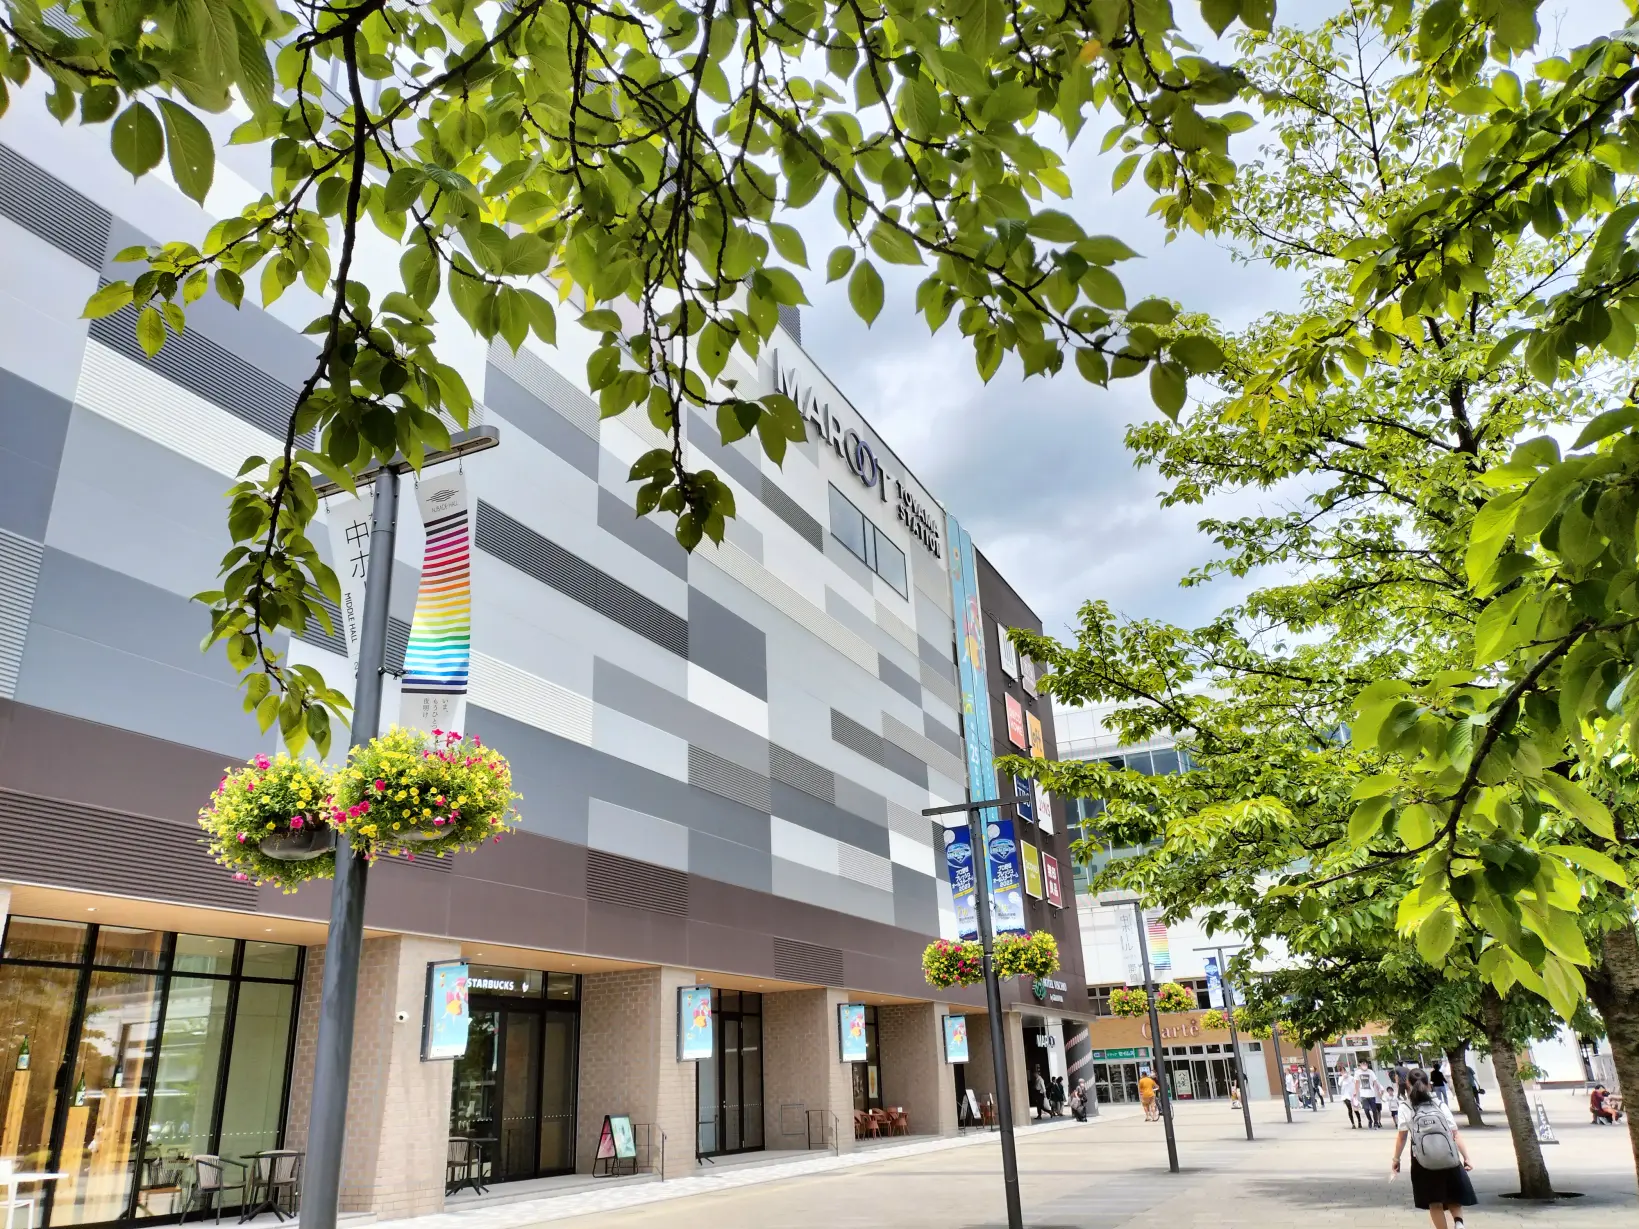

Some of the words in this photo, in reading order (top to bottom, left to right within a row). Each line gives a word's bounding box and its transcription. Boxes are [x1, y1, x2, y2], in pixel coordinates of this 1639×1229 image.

[773, 348, 894, 503] MAROOT
[895, 480, 940, 539] TOYAMA
[896, 504, 941, 560] STATION
[344, 592, 356, 622] MIDDLE
[349, 623, 358, 643] HALL
[466, 977, 515, 991] STARBUCKS
[1141, 1018, 1199, 1041] Carté
